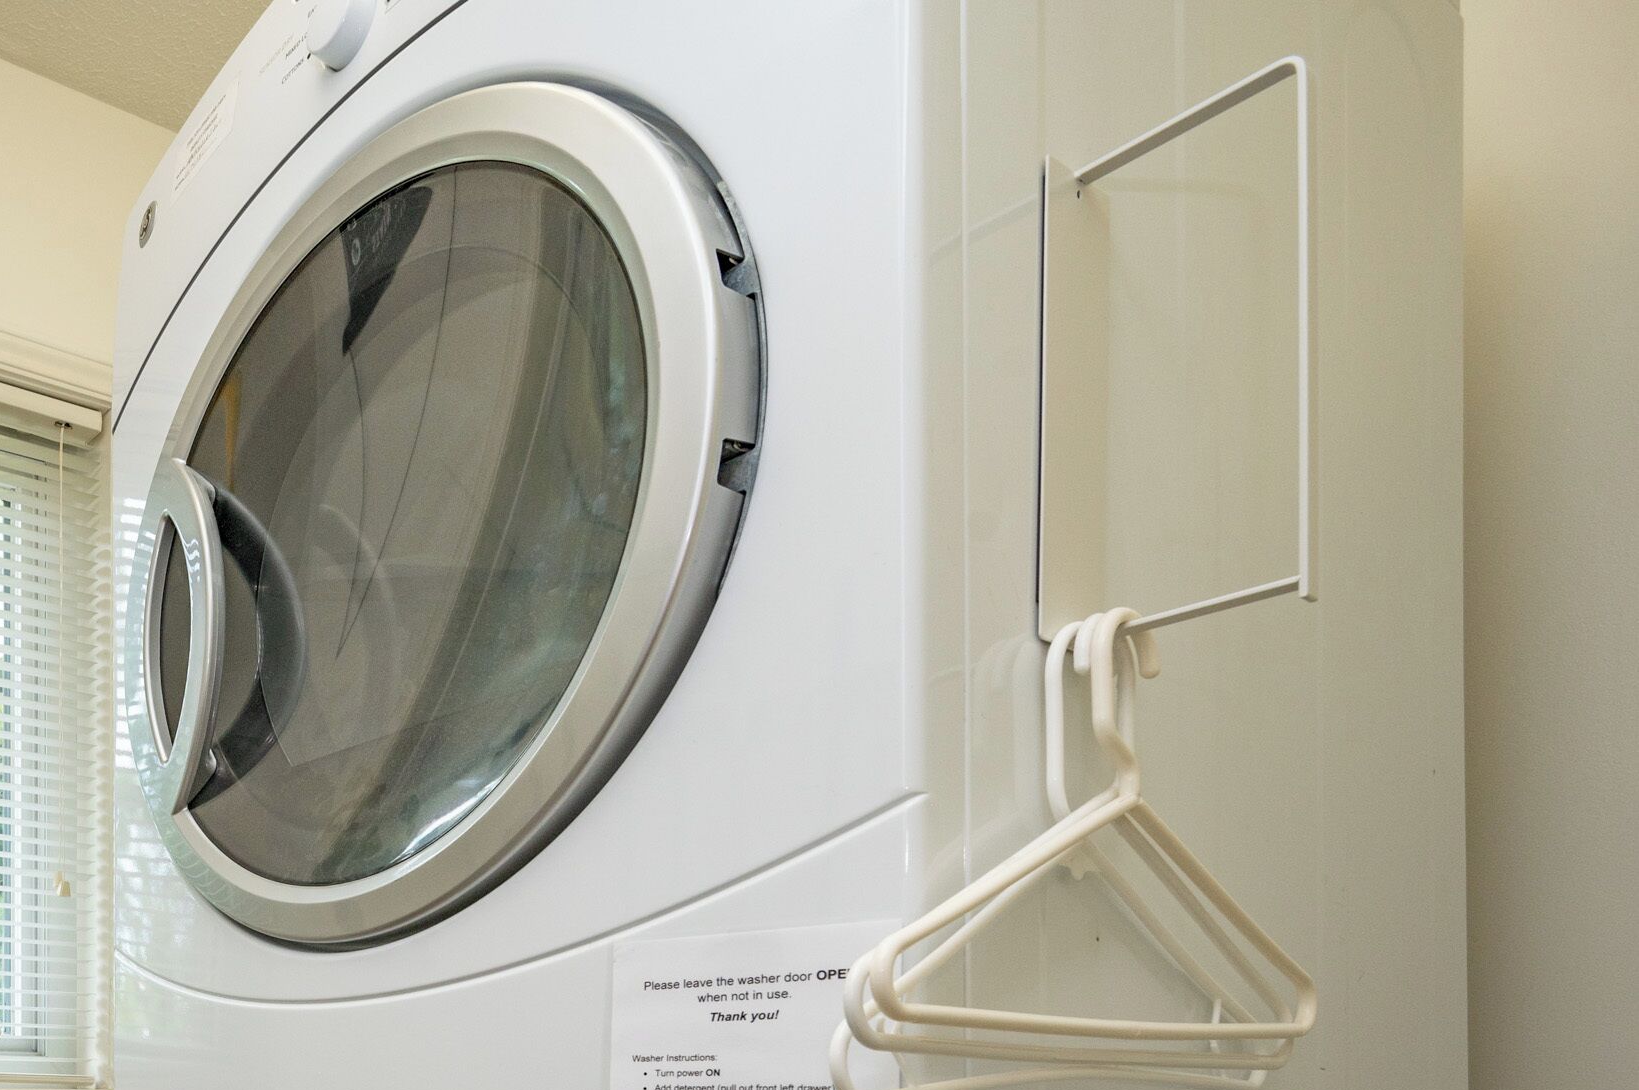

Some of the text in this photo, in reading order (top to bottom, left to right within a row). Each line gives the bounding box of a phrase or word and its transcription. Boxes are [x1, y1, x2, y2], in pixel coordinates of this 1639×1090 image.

[643, 968, 850, 990] Please leave the washer door OPE
[697, 990, 791, 1002] when not in use.
[710, 1009, 779, 1022] Thank you!
[631, 1053, 717, 1062] Washer Instructions:
[654, 1068, 720, 1078] Turn power ON
